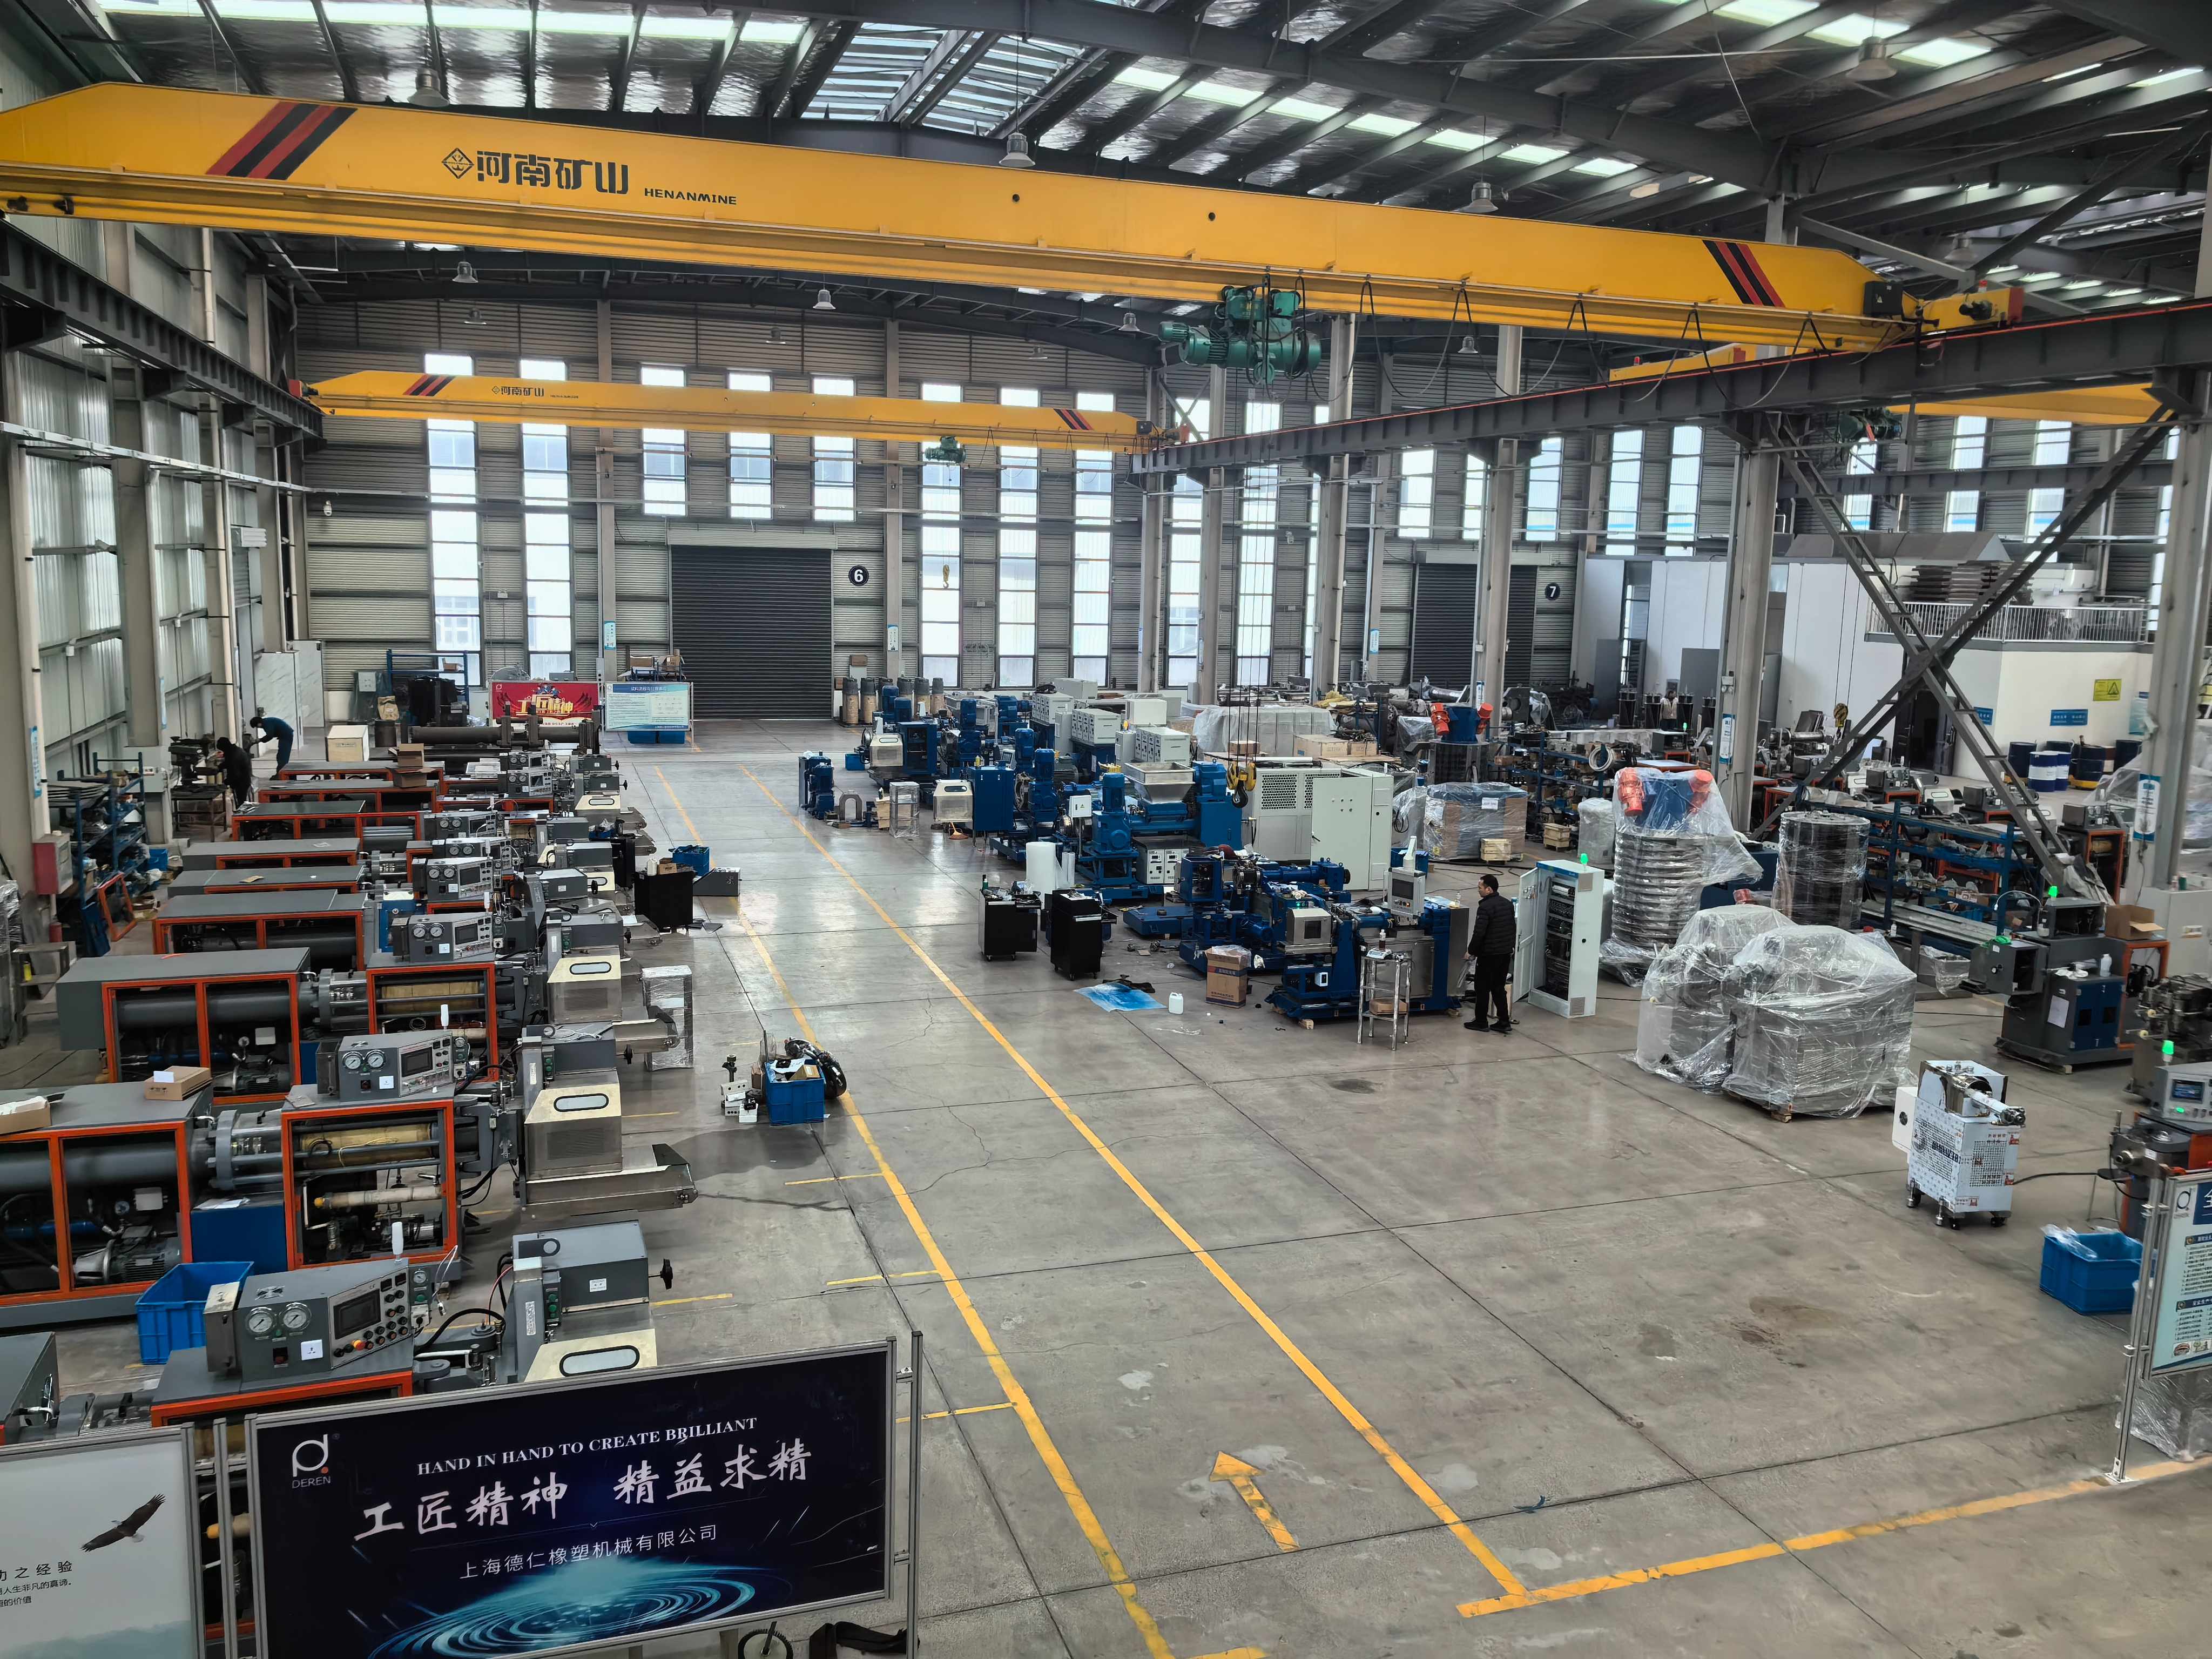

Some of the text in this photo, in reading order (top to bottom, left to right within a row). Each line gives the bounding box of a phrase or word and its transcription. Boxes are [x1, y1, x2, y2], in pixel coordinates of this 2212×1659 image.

[477, 150, 629, 194] 河南矿山
[644, 187, 737, 205] HENANMINE
[501, 386, 544, 397] 河南矿山
[855, 570, 864, 582] 6
[1549, 586, 1556, 597] 7
[417, 1418, 757, 1475] HAND IN HAND TO CREATE BRILLIANT
[292, 1476, 331, 1488] DEREN
[354, 1438, 812, 1541] 工匠精神 精益求精
[459, 1524, 716, 1580] 上海德仁橡塑机械有限公司
